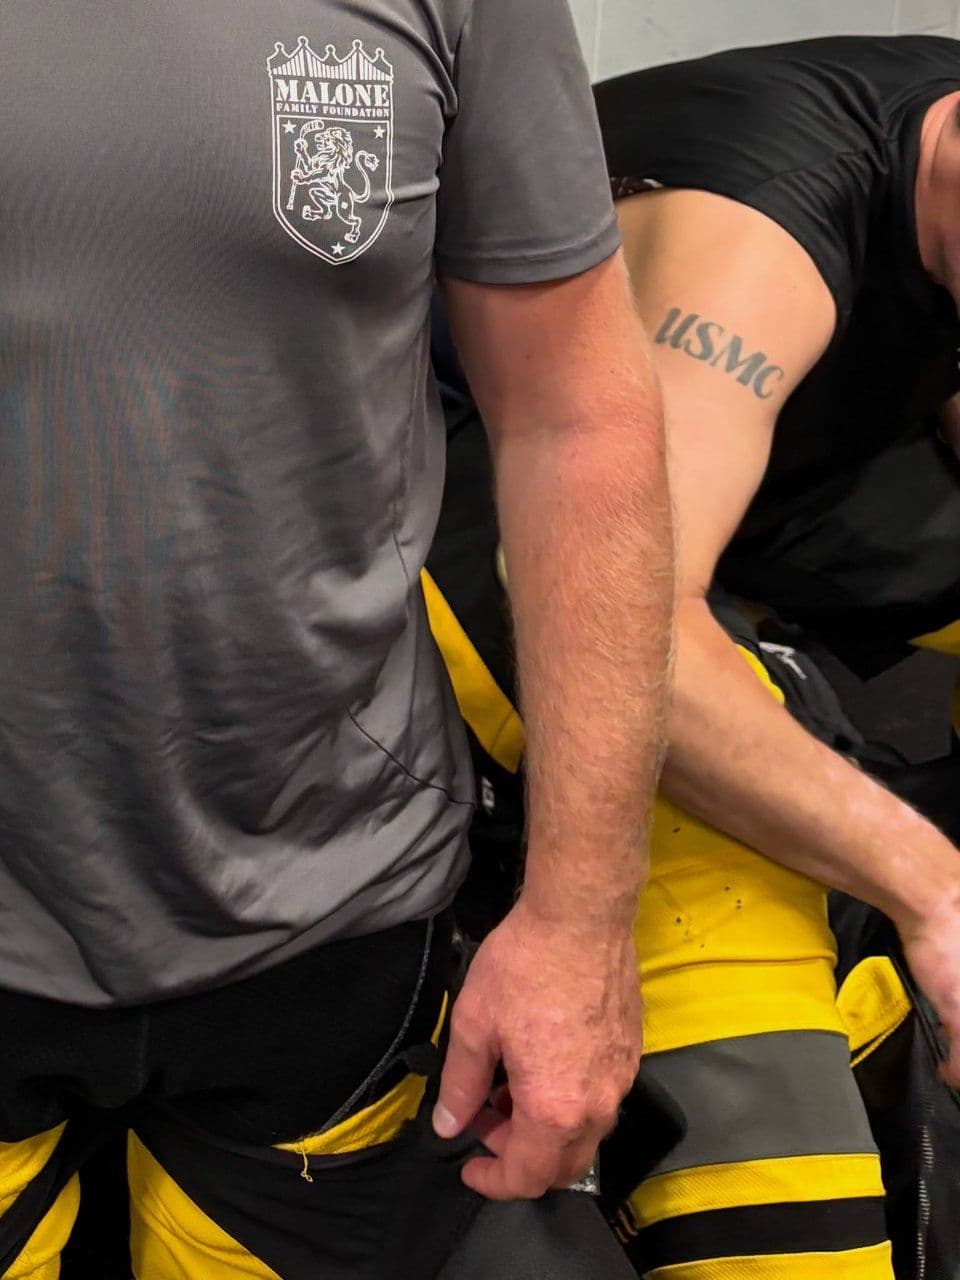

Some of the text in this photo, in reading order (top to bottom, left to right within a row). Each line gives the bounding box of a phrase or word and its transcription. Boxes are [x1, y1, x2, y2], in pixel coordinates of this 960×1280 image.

[276, 79, 390, 107] MALONE
[276, 102, 390, 118] FAMILY FOUNDATION
[654, 307, 784, 400] USMC
